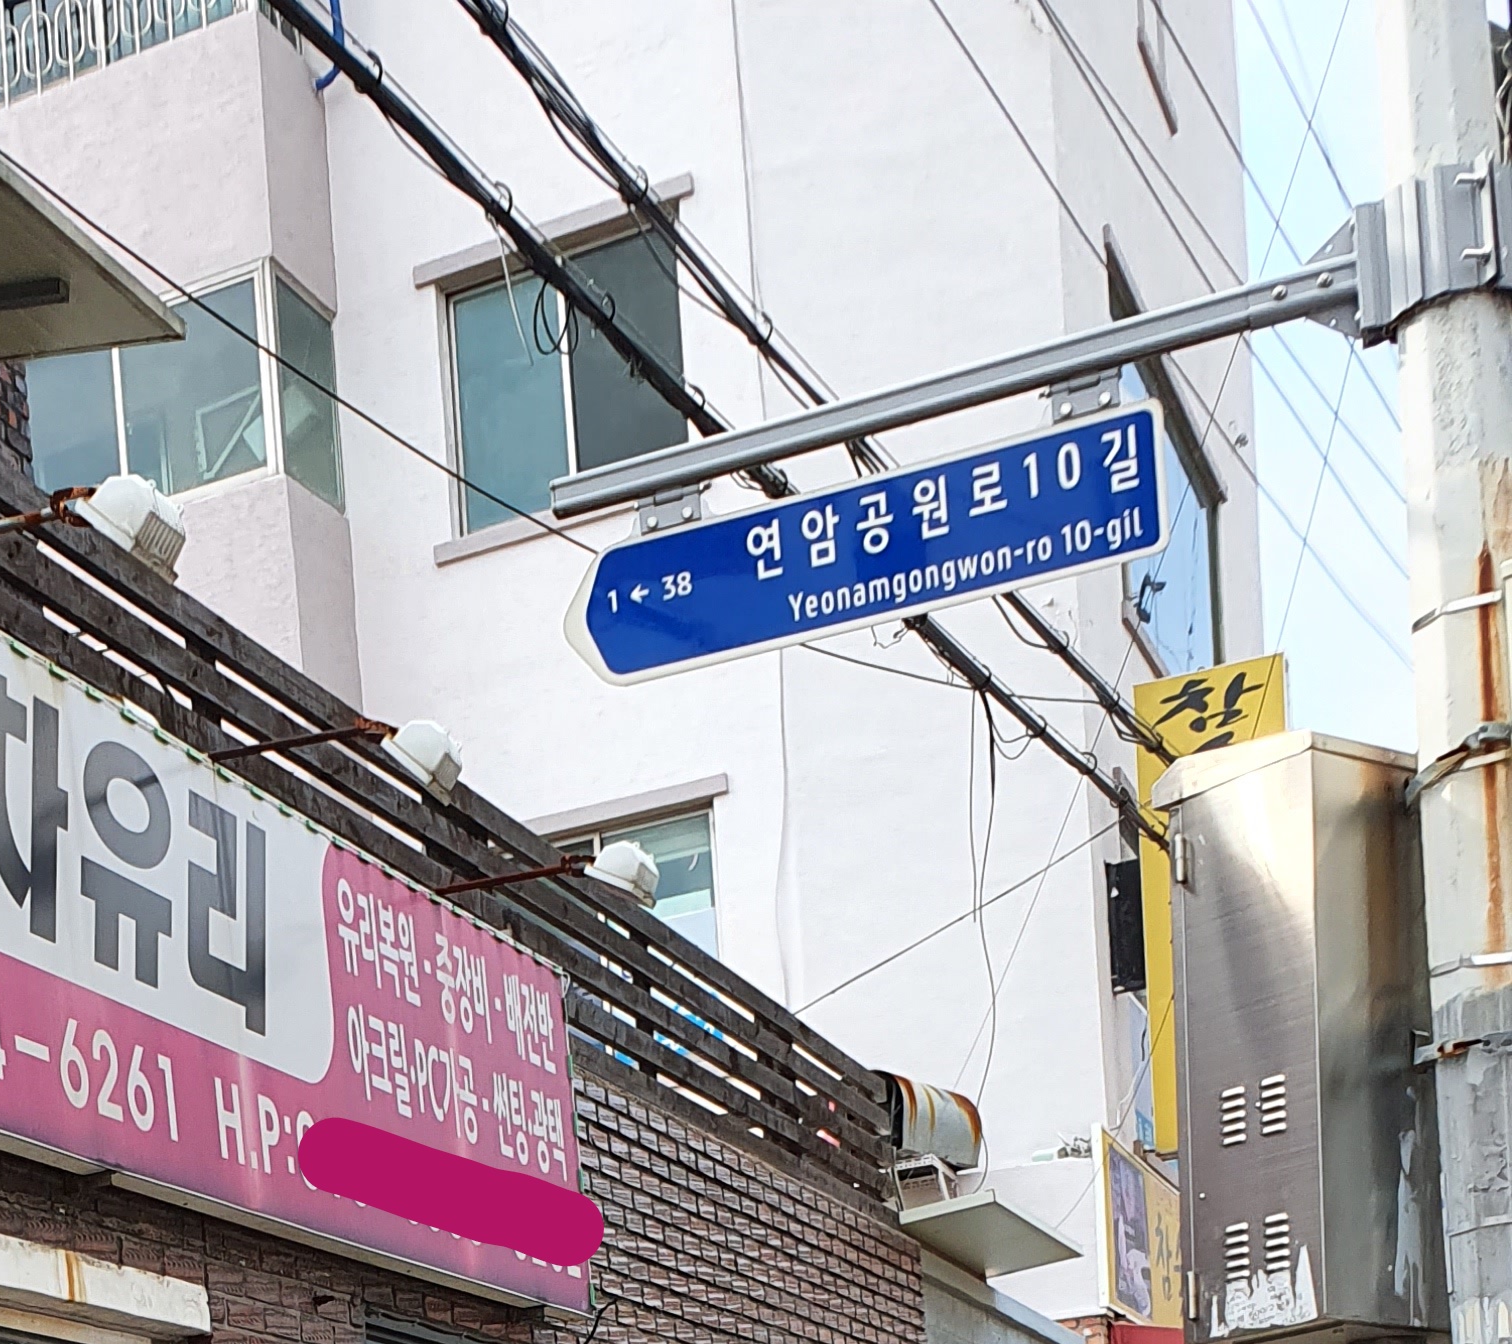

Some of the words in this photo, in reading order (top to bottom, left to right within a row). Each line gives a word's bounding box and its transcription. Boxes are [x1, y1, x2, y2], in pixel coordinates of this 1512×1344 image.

[606, 590, 620, 615] 1
[660, 571, 693, 602] 38
[787, 538, 1053, 624] Yeonamgongwon-ro
[1060, 505, 1145, 558] 10-gil
